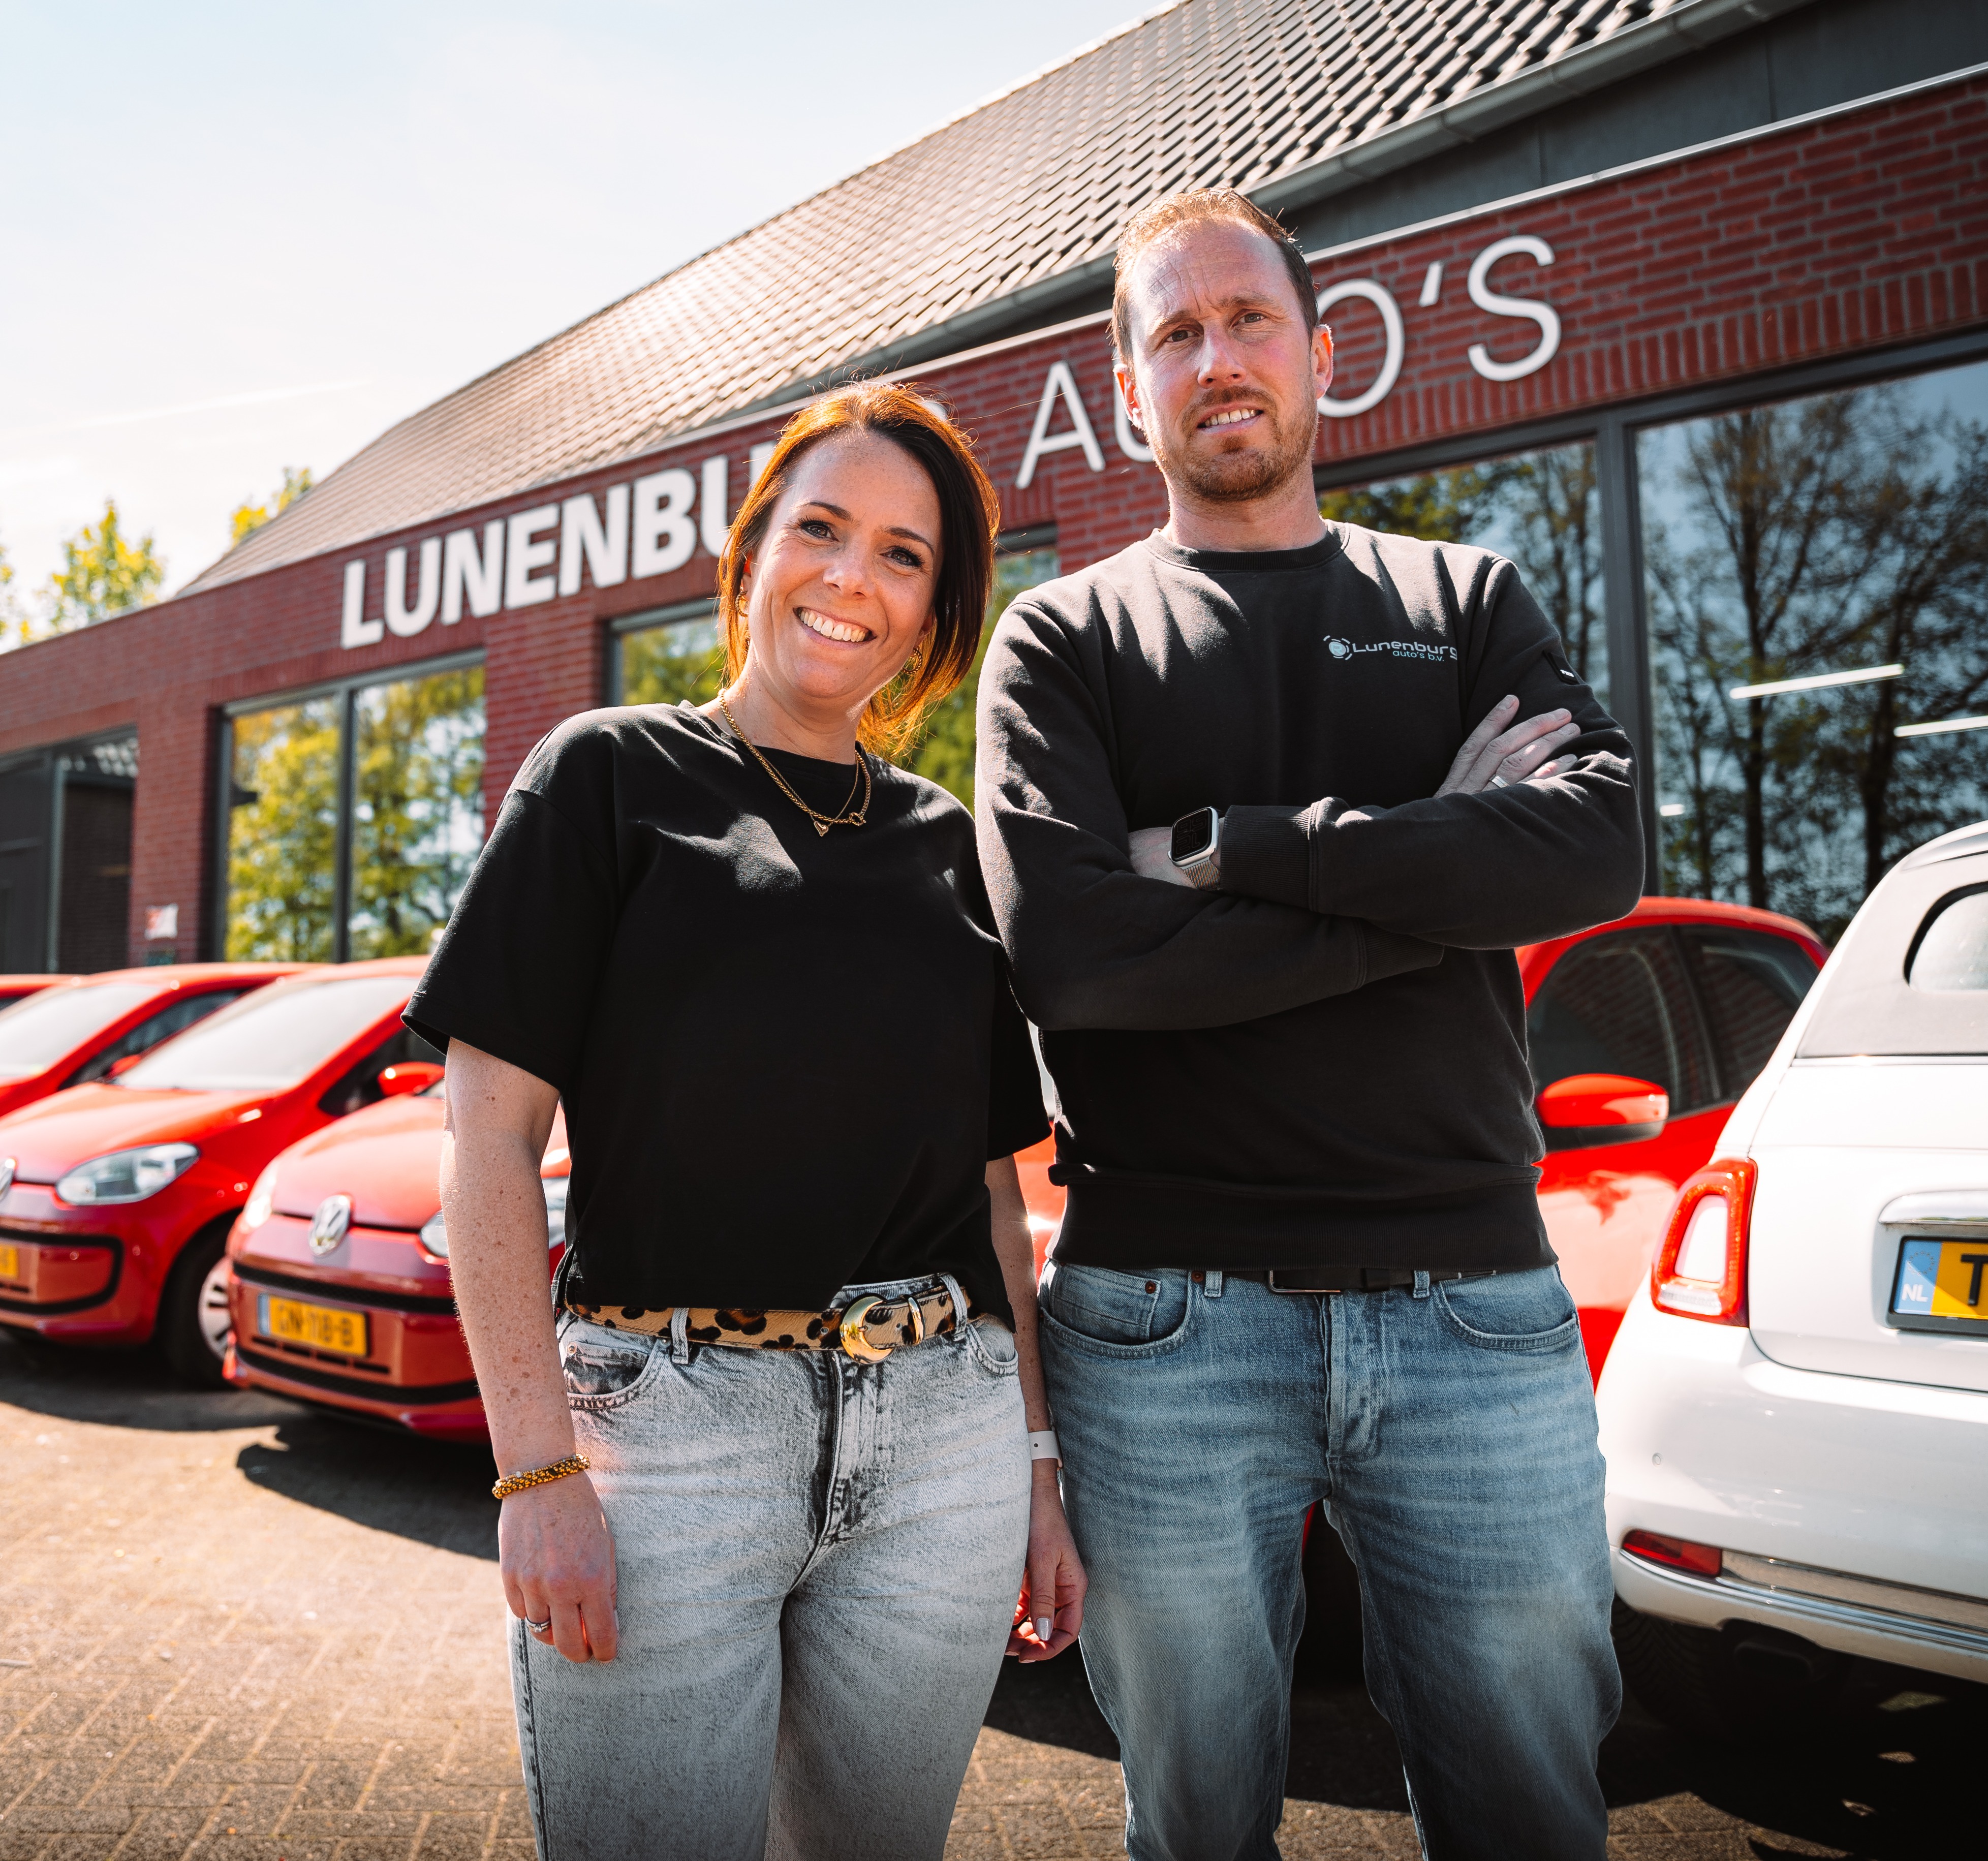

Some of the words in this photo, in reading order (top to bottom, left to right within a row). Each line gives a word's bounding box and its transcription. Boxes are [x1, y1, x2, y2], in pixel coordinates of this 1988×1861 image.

[340, 399, 949, 649] LUNENBU
[1392, 650, 1425, 659] auto's
[1428, 653, 1444, 662] b.v.
[1902, 1283, 1929, 1302] NL
